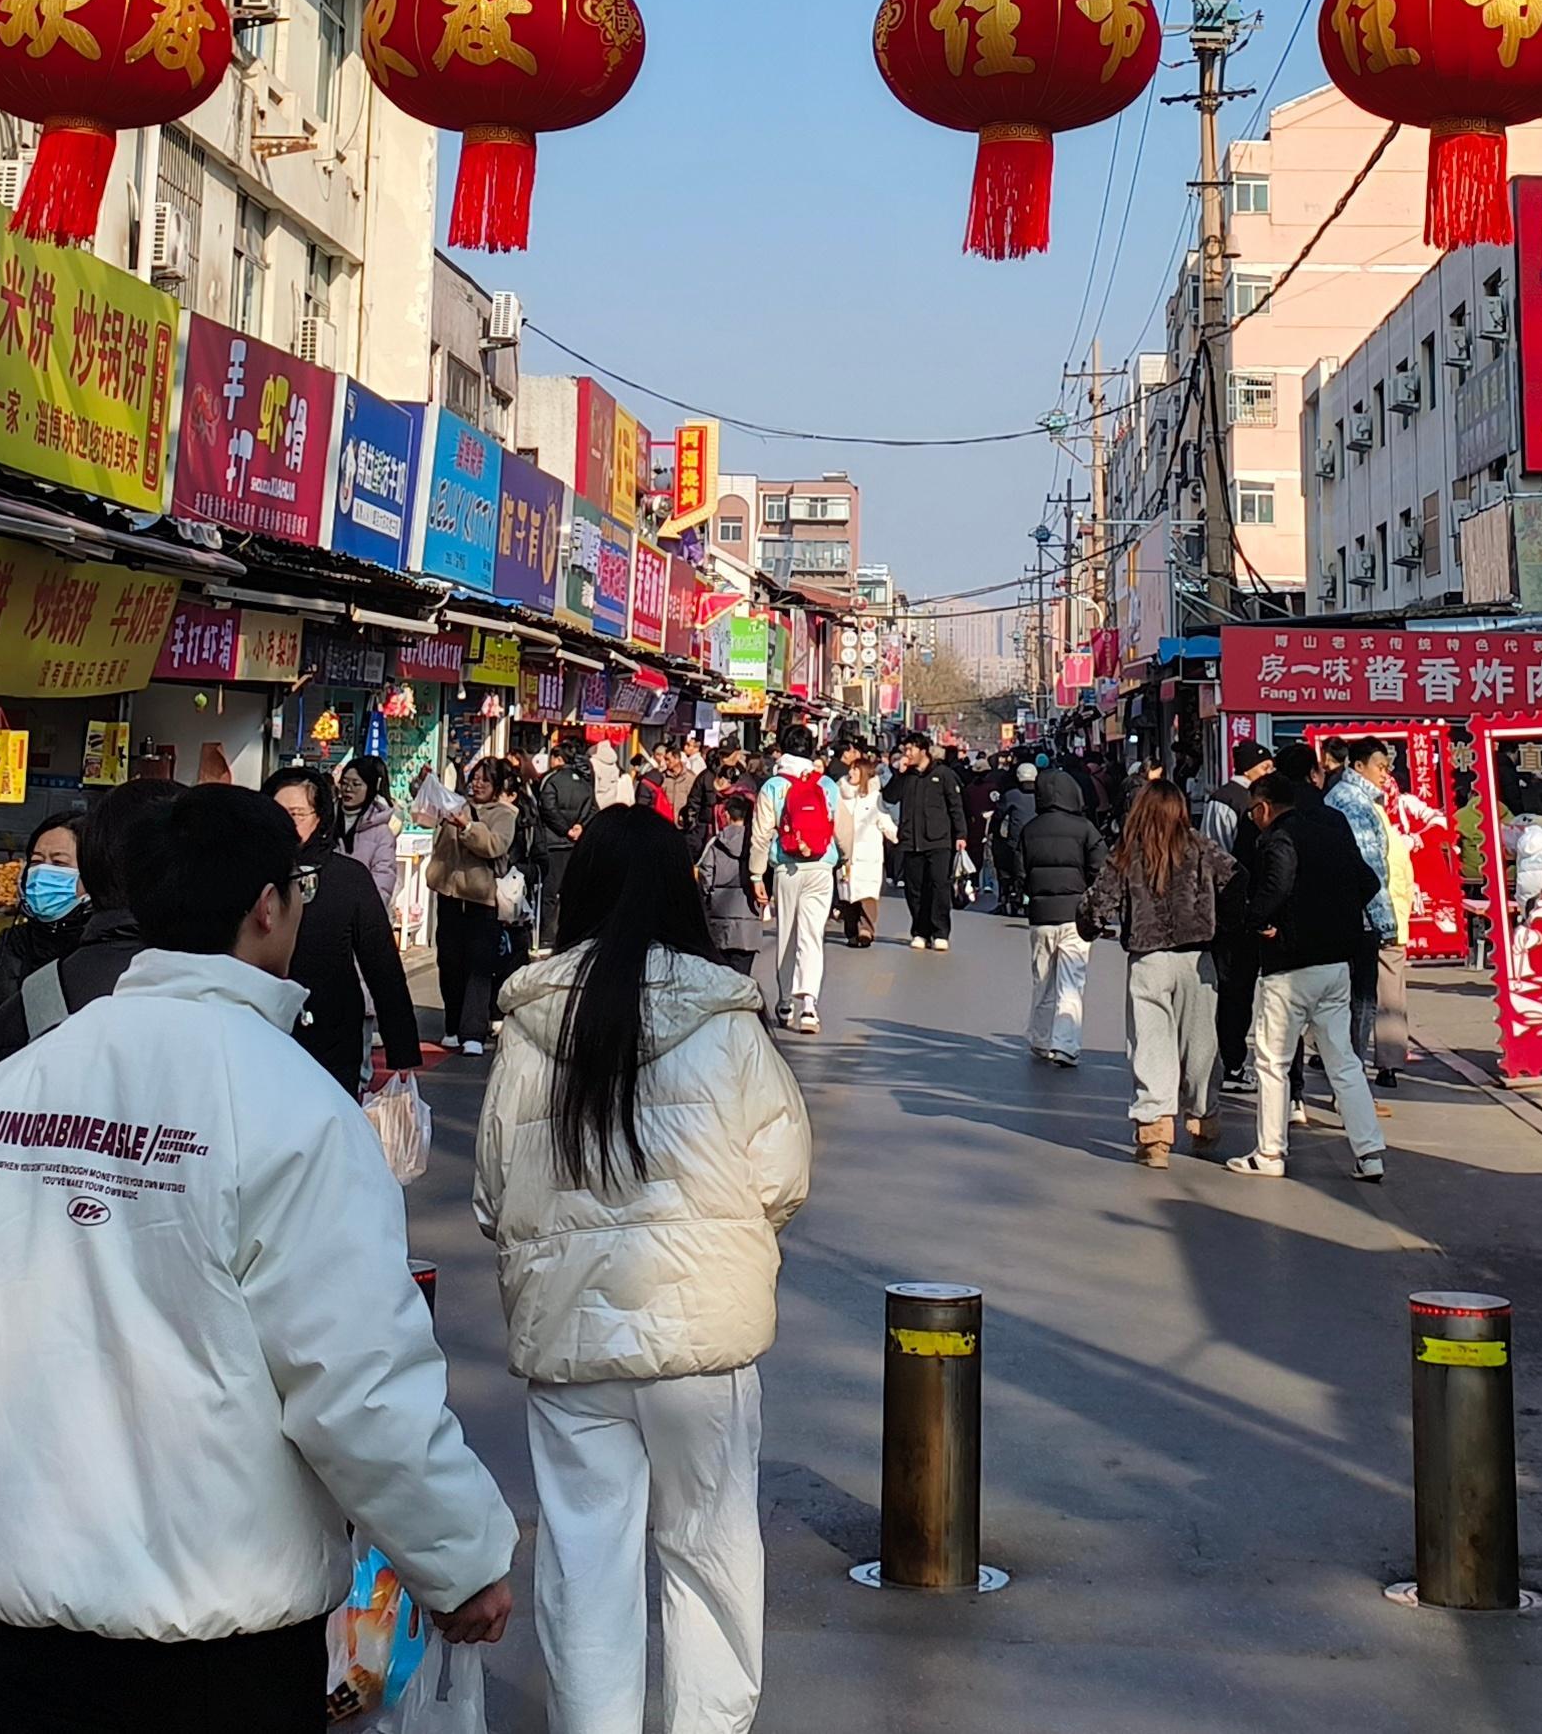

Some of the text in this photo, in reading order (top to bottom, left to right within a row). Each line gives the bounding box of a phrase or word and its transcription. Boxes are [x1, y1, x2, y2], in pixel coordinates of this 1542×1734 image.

[69, 288, 149, 410] 炒锅饼
[24, 571, 100, 649] 炒锅饼
[1258, 654, 1353, 683] 房一味
[1260, 687, 1297, 702] Fang
[1323, 688, 1350, 701] Wei
